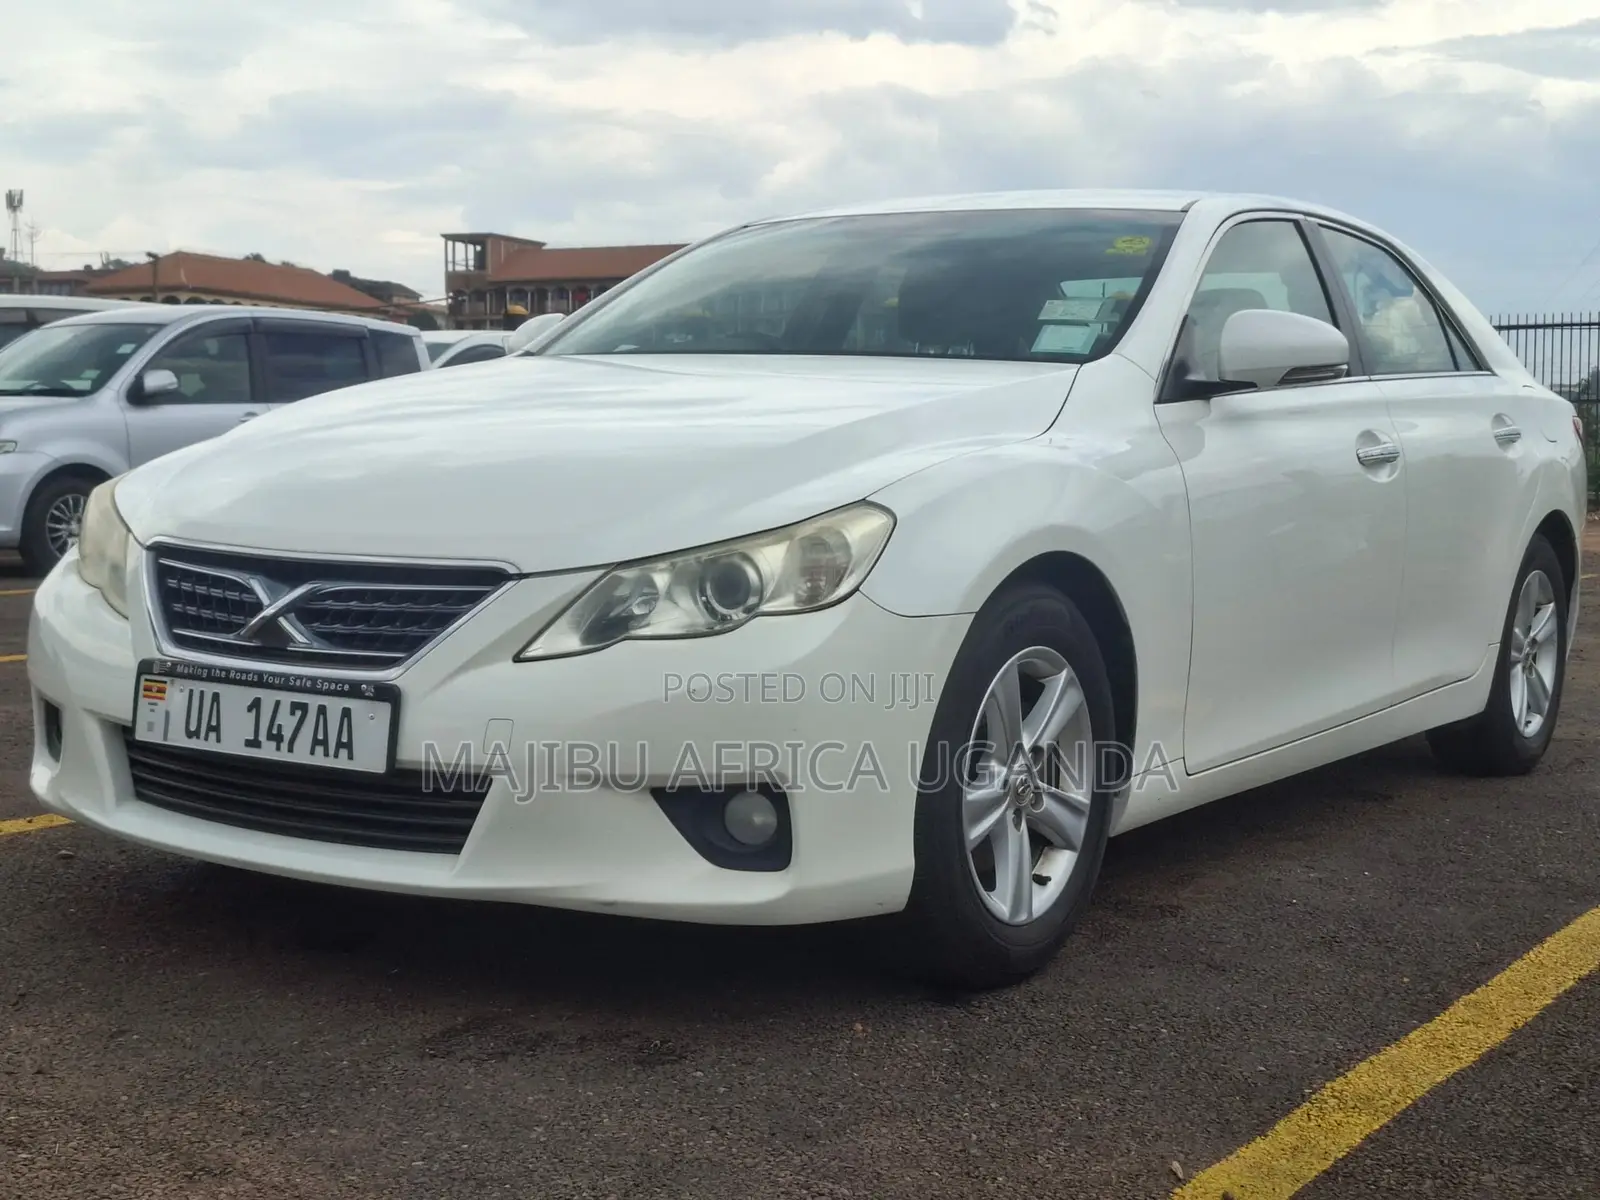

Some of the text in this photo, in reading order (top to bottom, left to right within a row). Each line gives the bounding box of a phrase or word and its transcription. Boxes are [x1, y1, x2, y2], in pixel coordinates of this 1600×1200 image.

[176, 664, 350, 692] Making the Roads Your Safe Space
[184, 688, 354, 760] UA 147AA
